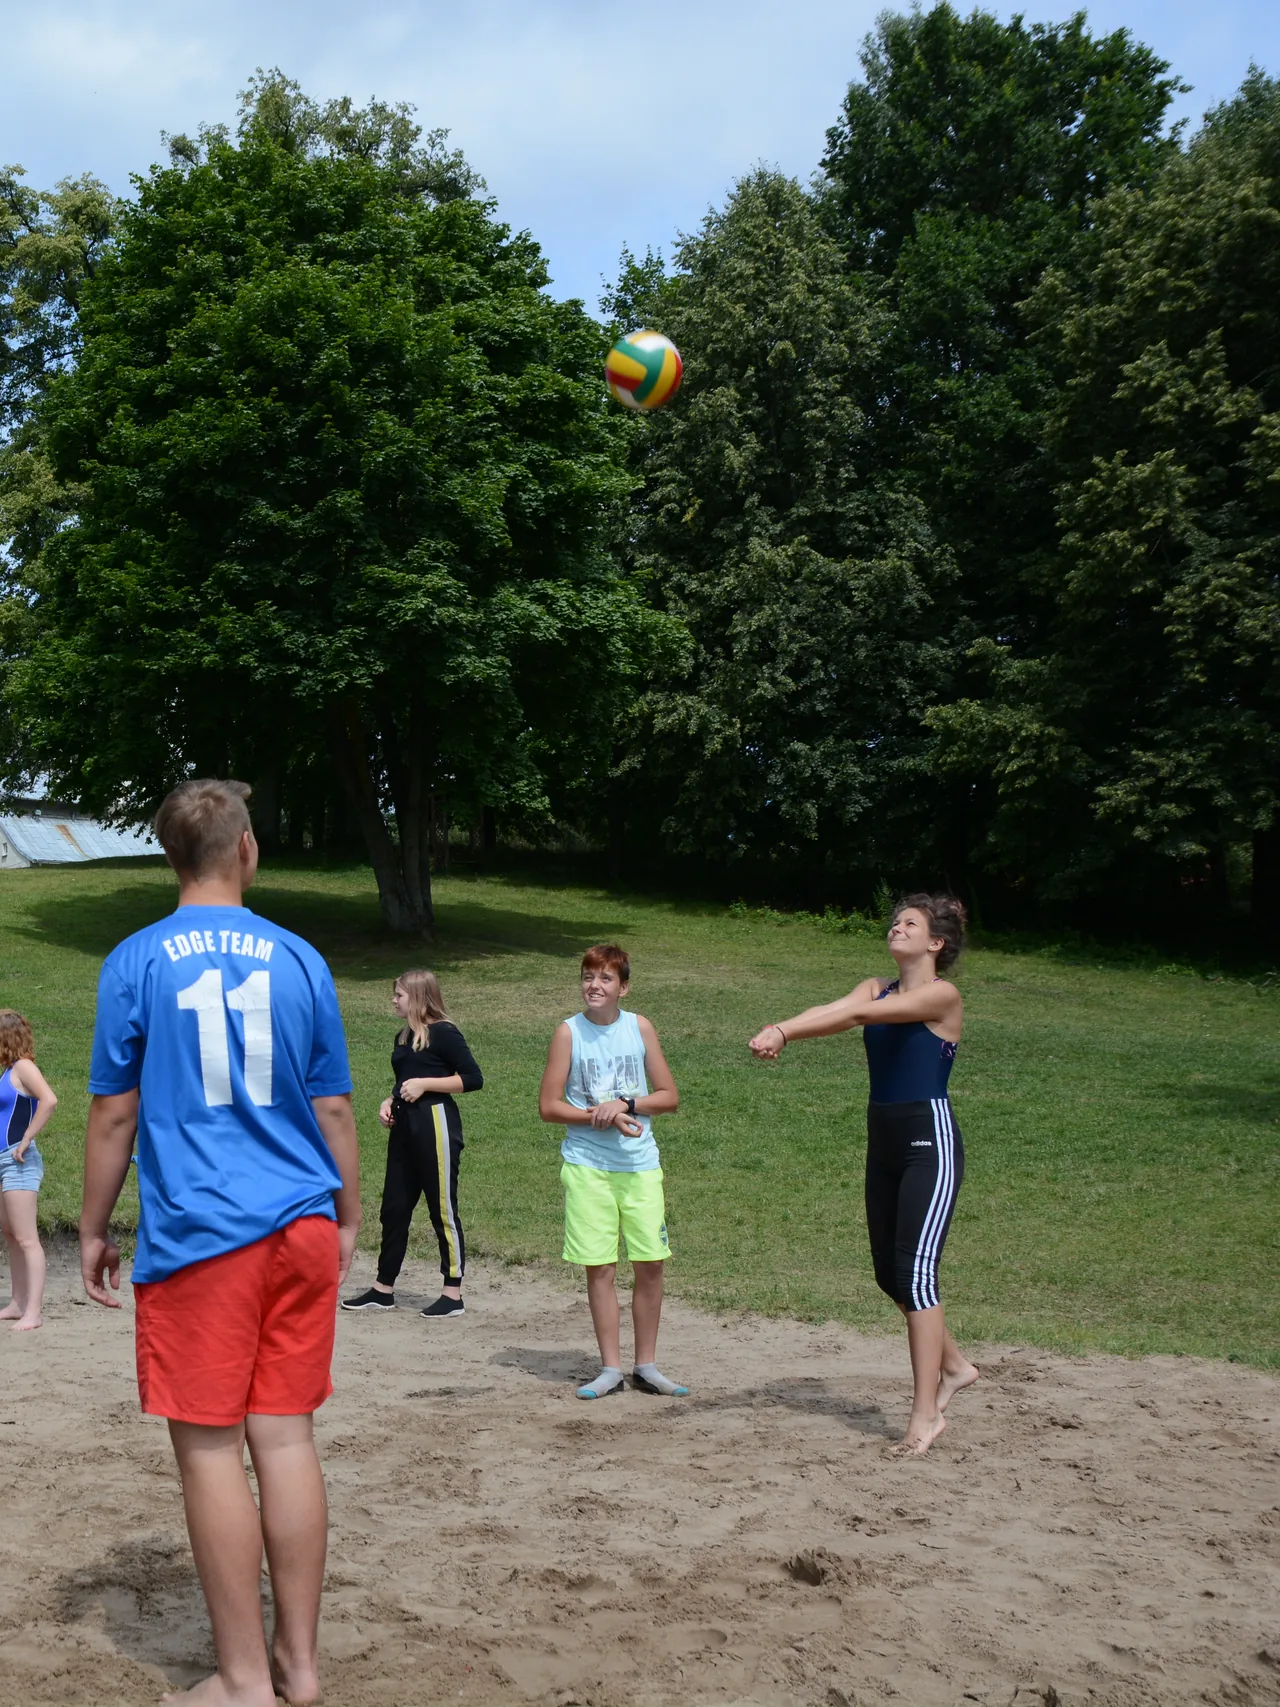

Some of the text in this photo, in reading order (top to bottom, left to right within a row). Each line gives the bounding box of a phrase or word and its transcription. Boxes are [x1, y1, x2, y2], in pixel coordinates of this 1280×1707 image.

[162, 930, 274, 962] EDGE TEAM
[176, 969, 273, 1107] 11
